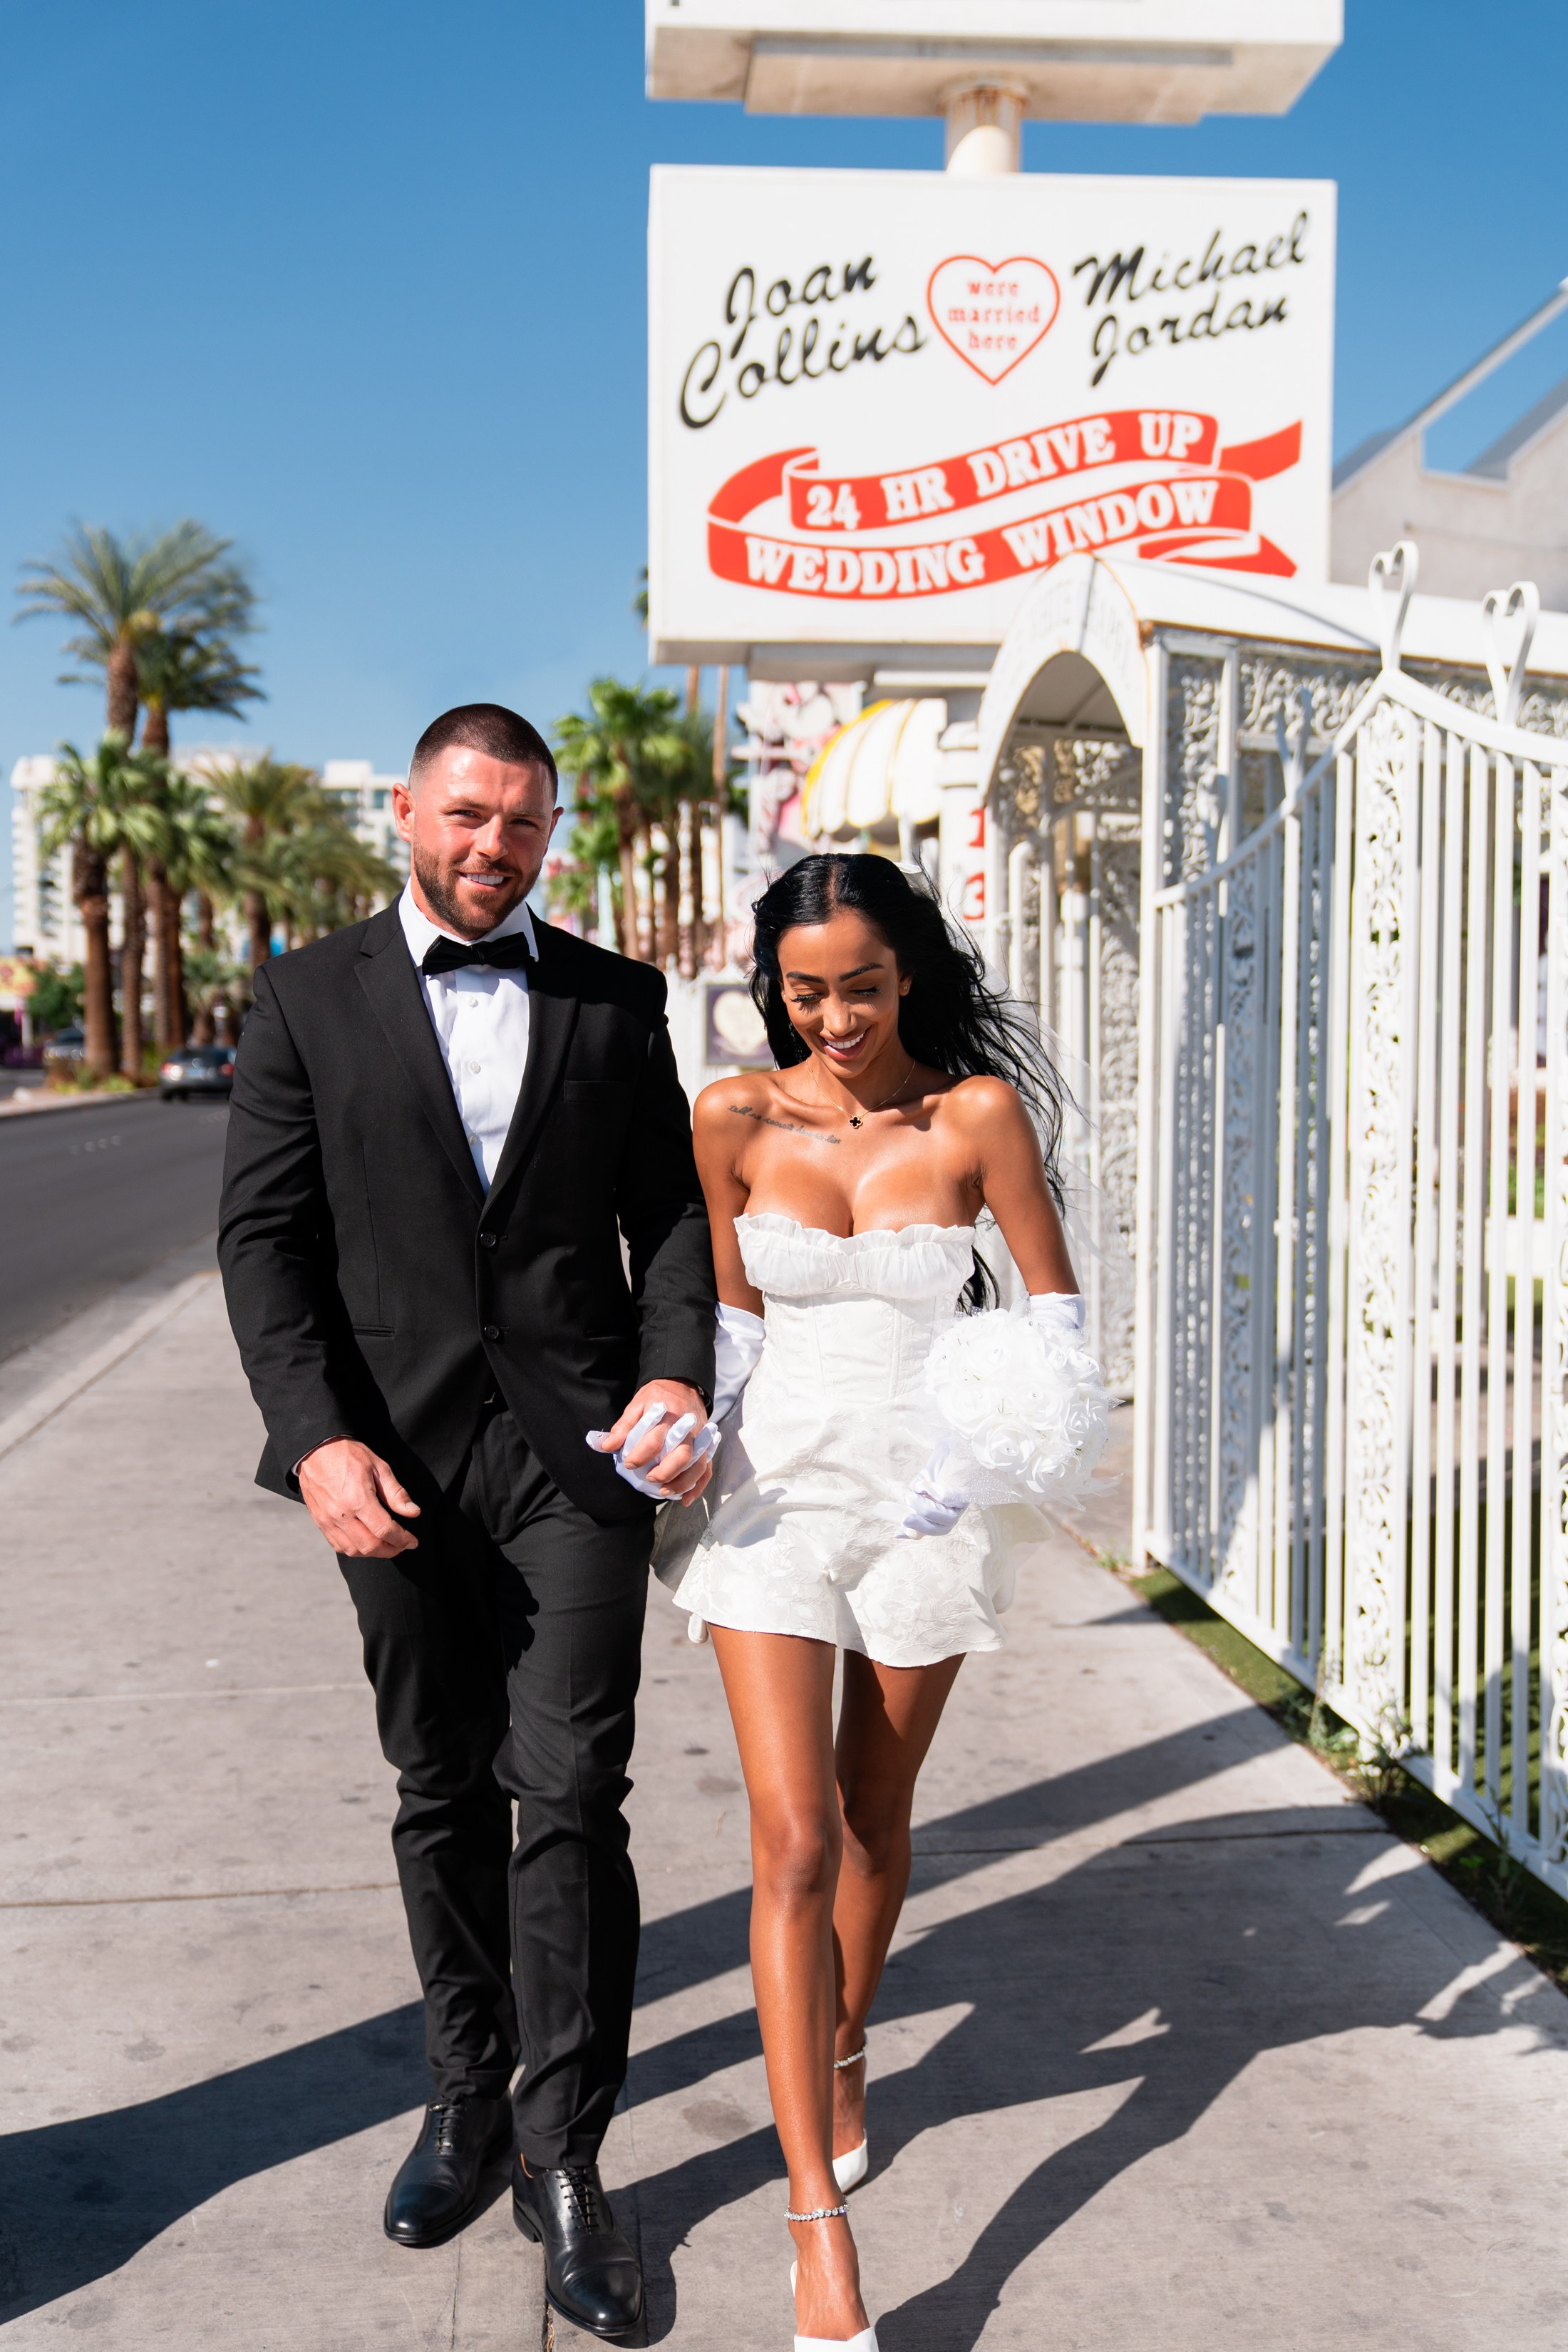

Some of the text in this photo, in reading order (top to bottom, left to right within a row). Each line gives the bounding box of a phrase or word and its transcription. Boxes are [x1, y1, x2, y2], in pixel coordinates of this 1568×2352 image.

[723, 255, 877, 361] Joan
[966, 280, 1018, 296] were
[1071, 210, 1309, 308] Michael
[947, 304, 1041, 324] married
[967, 330, 1017, 350] here
[1090, 292, 1289, 388] Jordan
[678, 315, 929, 430] Collins
[807, 413, 1203, 530] 24 HR DRIVE UP
[746, 480, 1219, 595] WEDDING WINDOW
